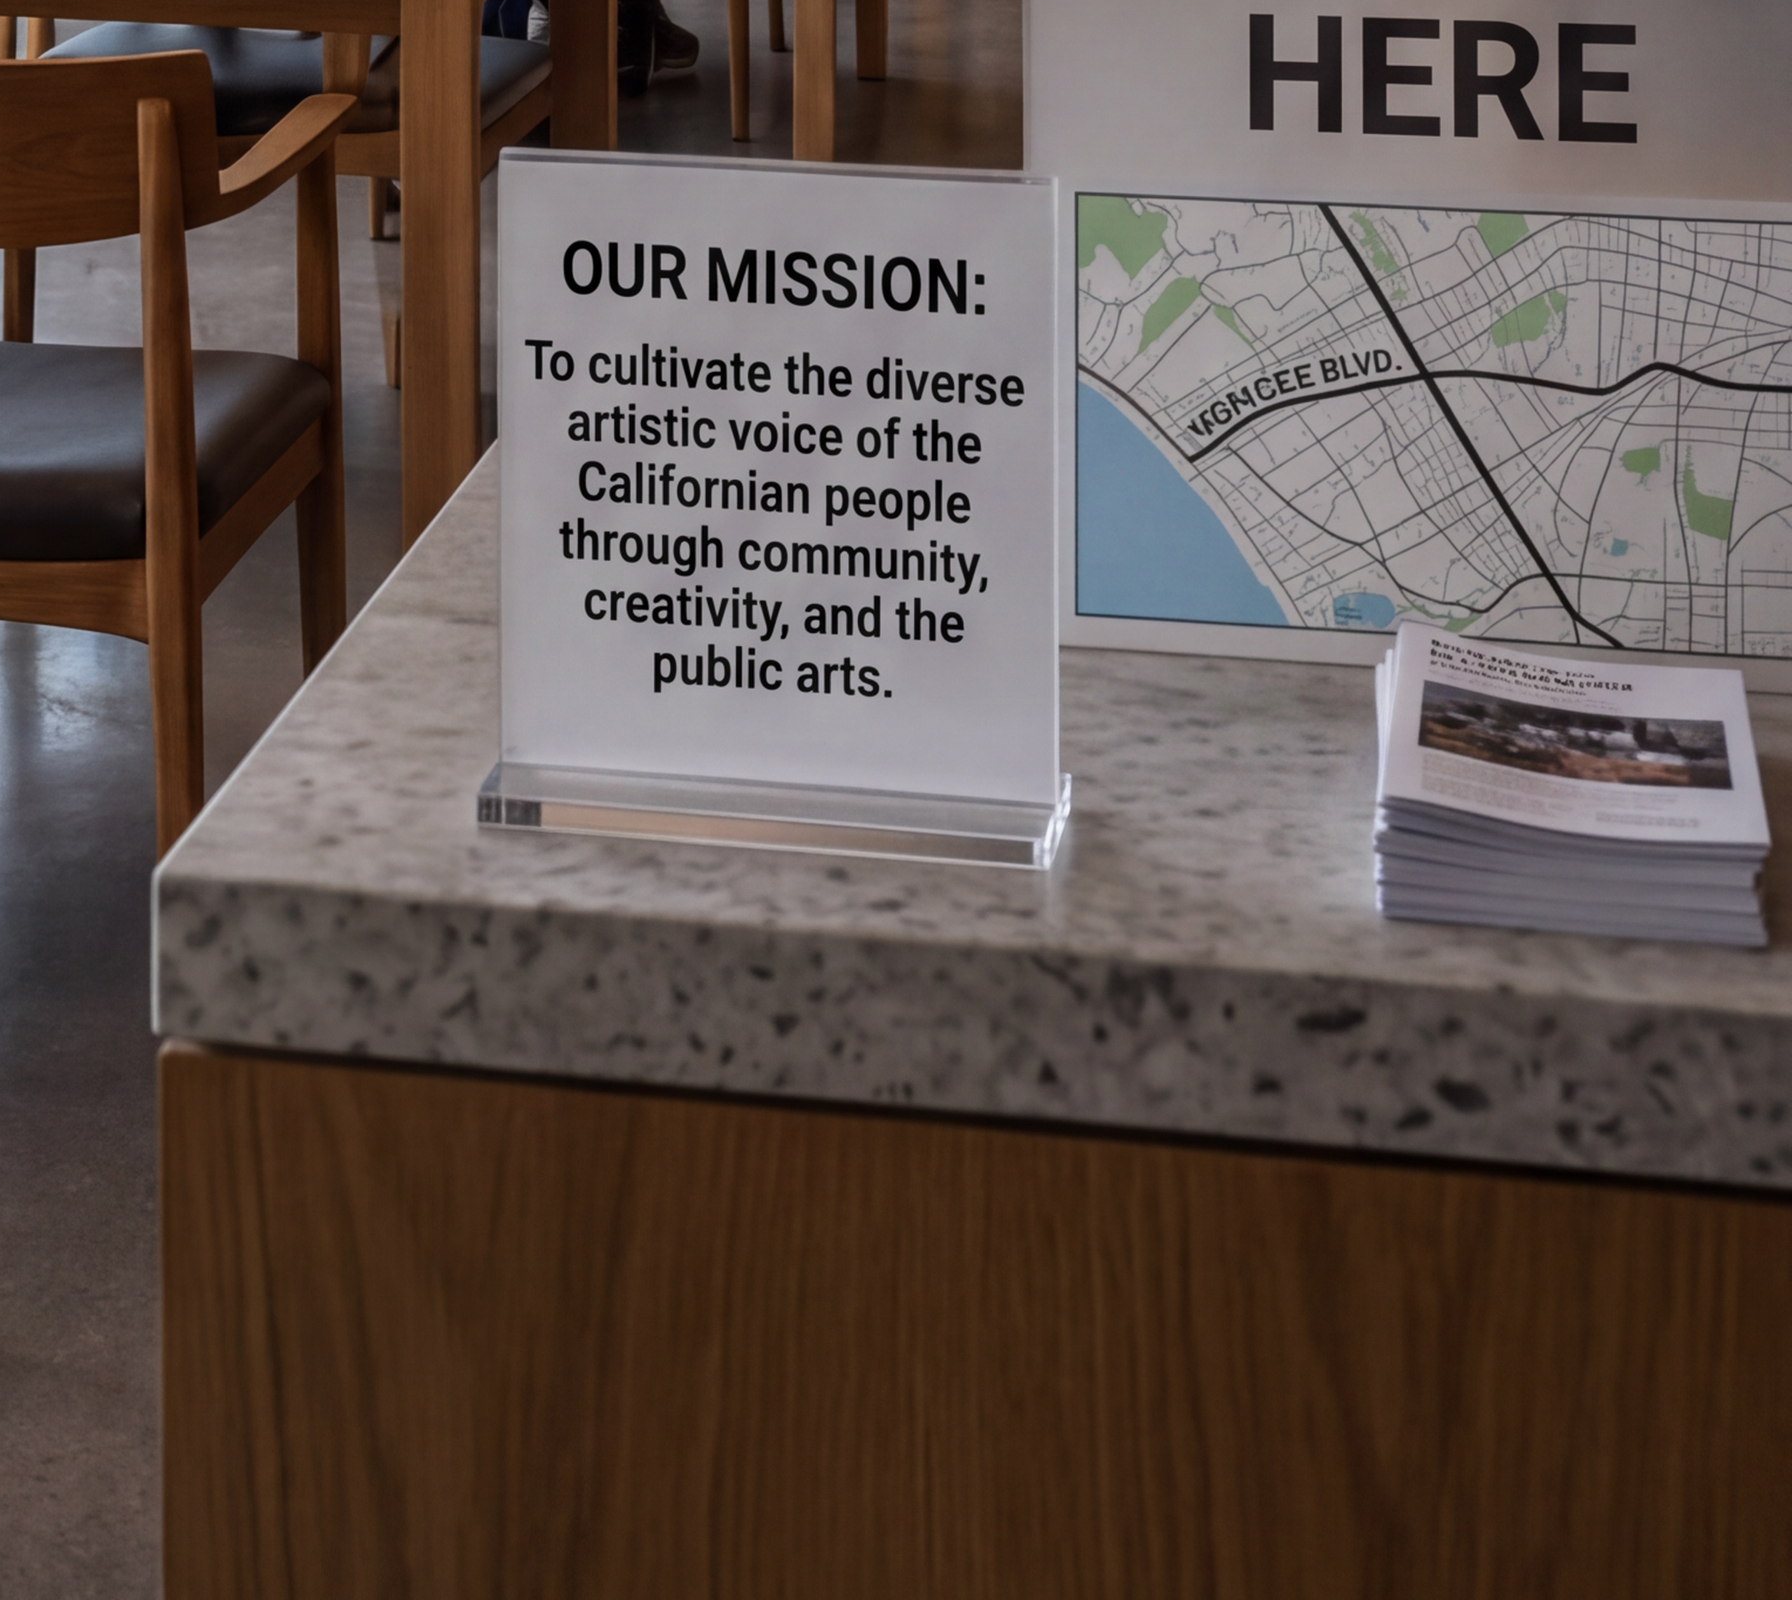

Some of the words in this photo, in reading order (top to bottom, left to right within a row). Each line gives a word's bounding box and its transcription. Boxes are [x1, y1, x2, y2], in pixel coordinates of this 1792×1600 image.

[1249, 13, 1638, 144] HERE
[562, 240, 688, 300] OUR
[708, 246, 986, 316] MISSION:
[524, 339, 575, 382] To
[588, 343, 772, 393] cultivate
[783, 351, 853, 398] the
[866, 356, 1025, 407] diverse
[1320, 349, 1402, 383] BLVD.
[567, 403, 716, 449] artistic
[728, 411, 843, 456] voice
[856, 416, 901, 459] of
[912, 418, 982, 465] the
[578, 460, 810, 514] Californian
[825, 479, 971, 532] people
[558, 517, 724, 577] through
[738, 539, 988, 593] community,
[584, 584, 792, 640] creativity,
[804, 595, 881, 638] and
[895, 597, 965, 644] the
[653, 643, 783, 693] public
[796, 657, 892, 698] arts.
